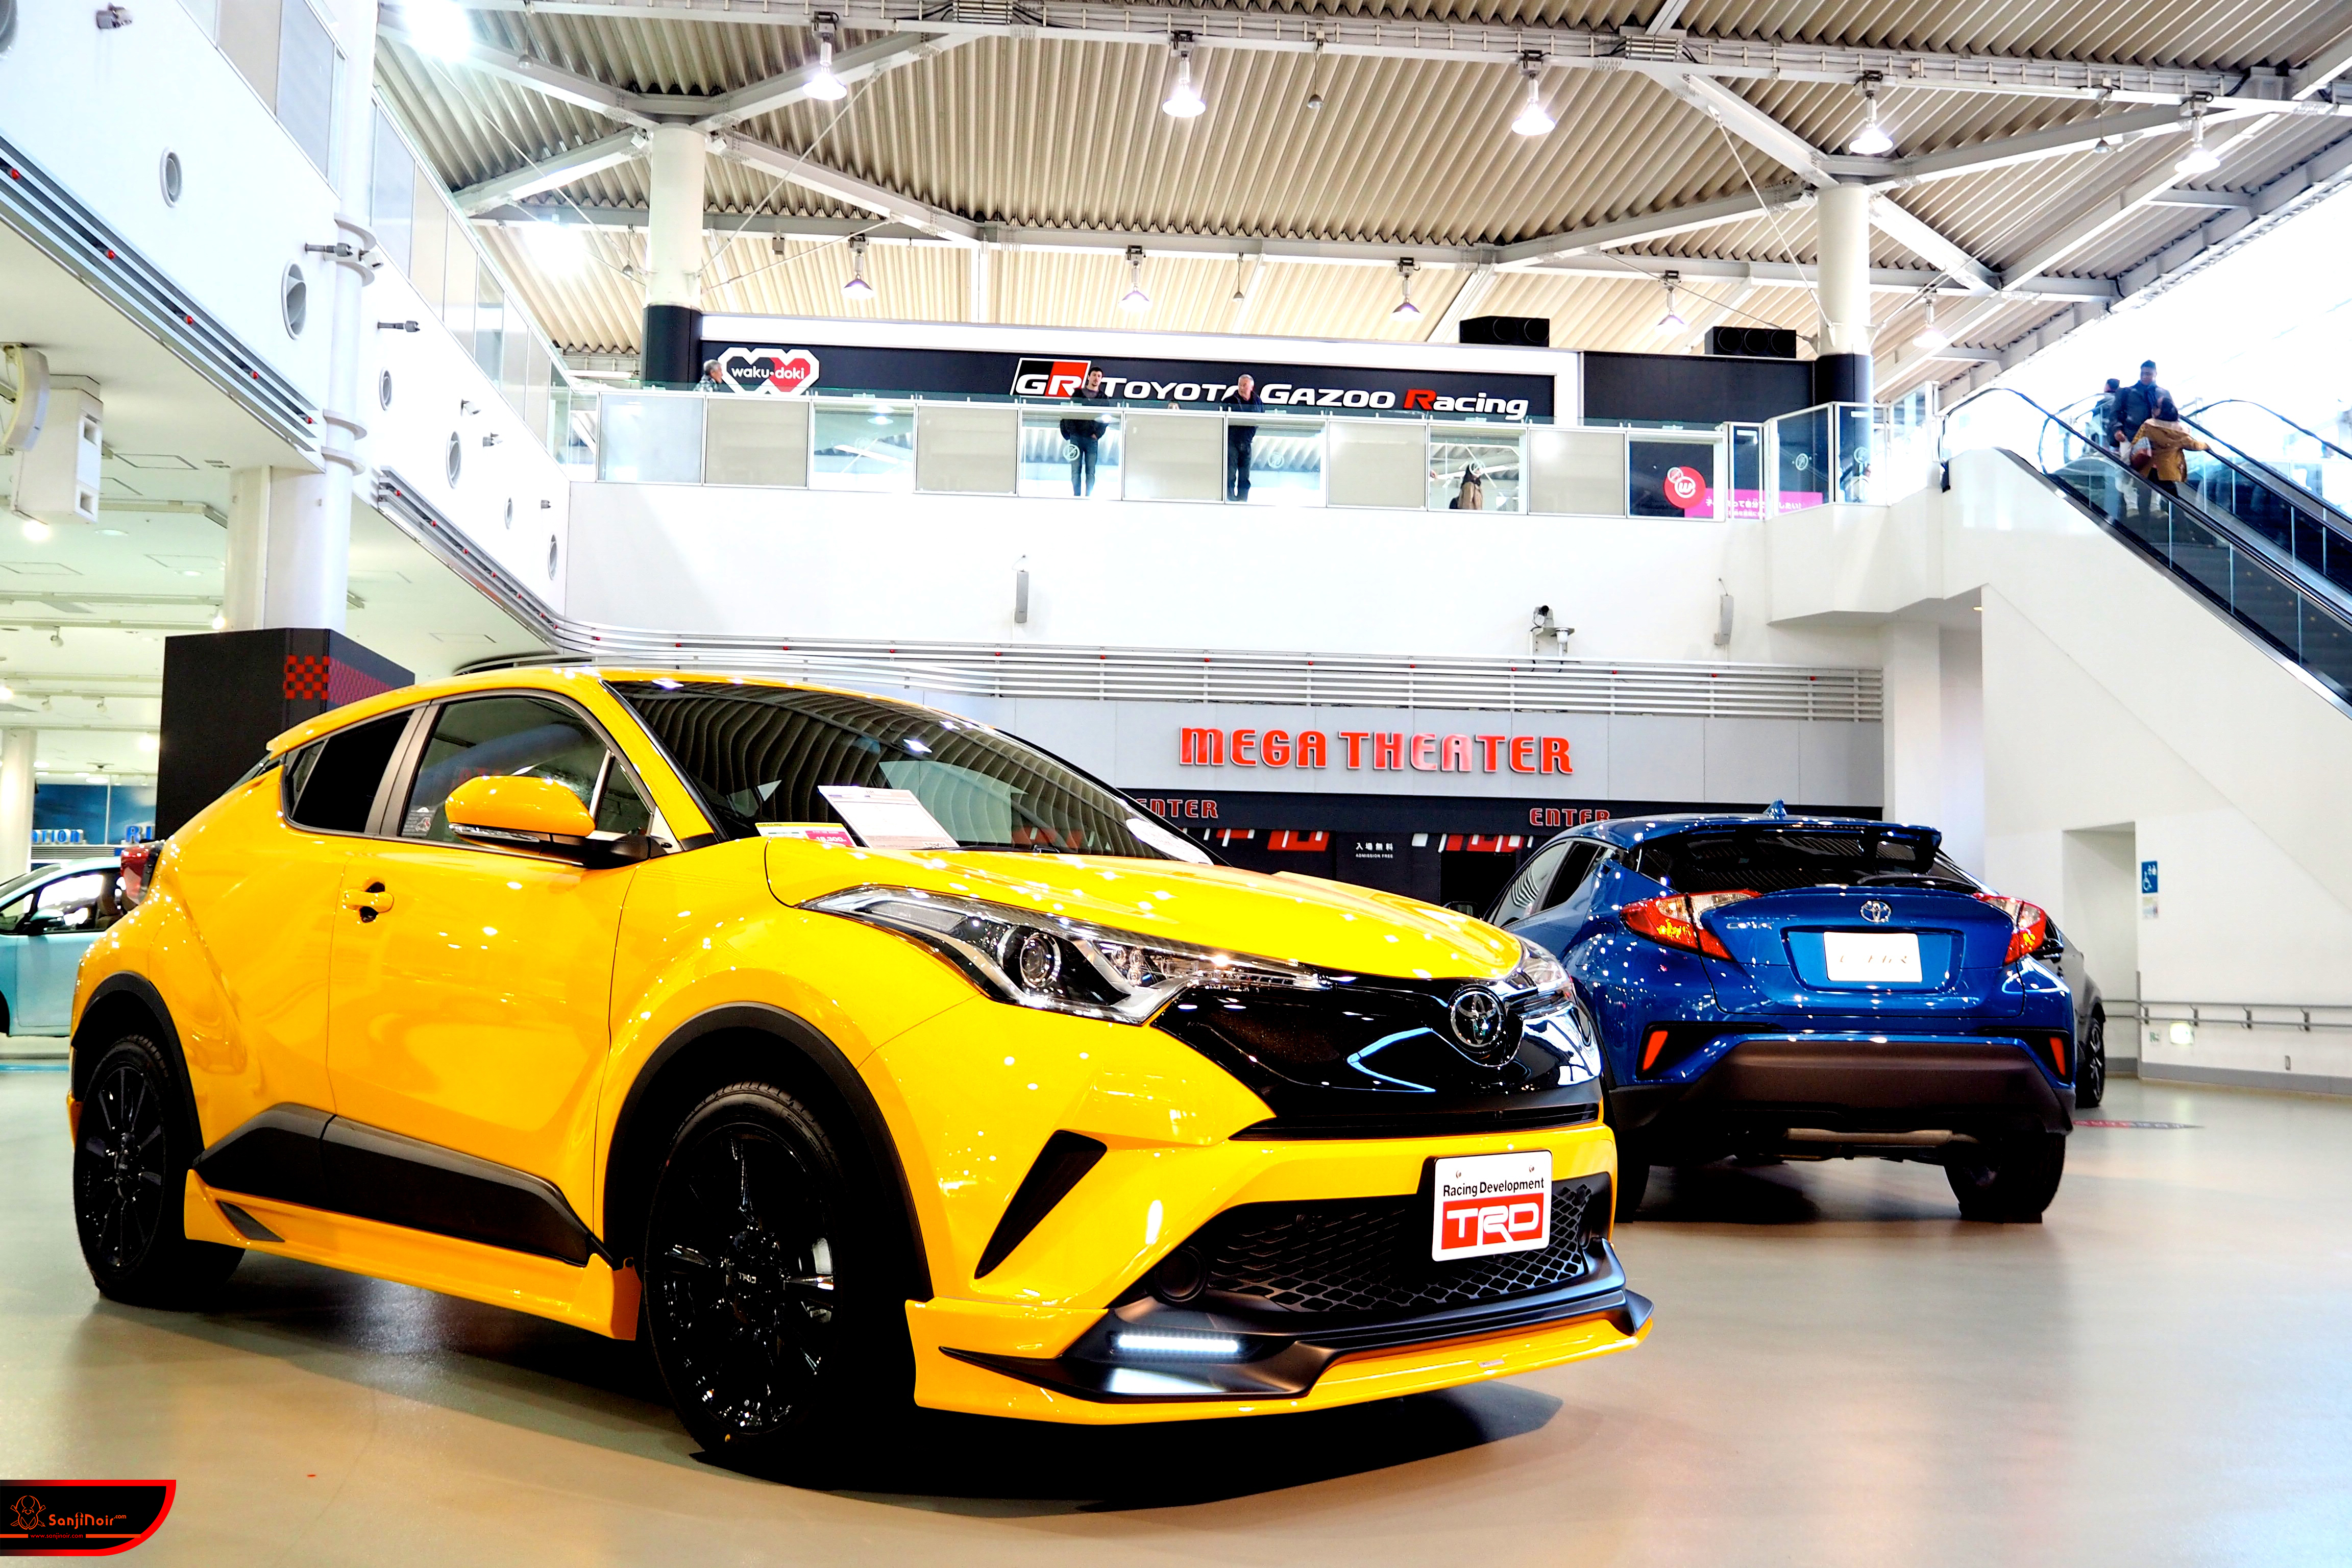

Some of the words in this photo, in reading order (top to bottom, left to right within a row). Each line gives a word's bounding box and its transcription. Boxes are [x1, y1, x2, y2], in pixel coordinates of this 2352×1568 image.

[1016, 374, 1082, 396] GR
[1260, 383, 1395, 408] GAZOO
[1404, 389, 1529, 421] Racing
[1180, 727, 1327, 768] MEGA
[1338, 731, 1574, 774] THEATER
[1355, 842, 1393, 851] 入場無料
[1443, 1183, 1478, 1197] Racing
[1480, 1177, 1544, 1193] Development
[1447, 1202, 1539, 1245] TRD
